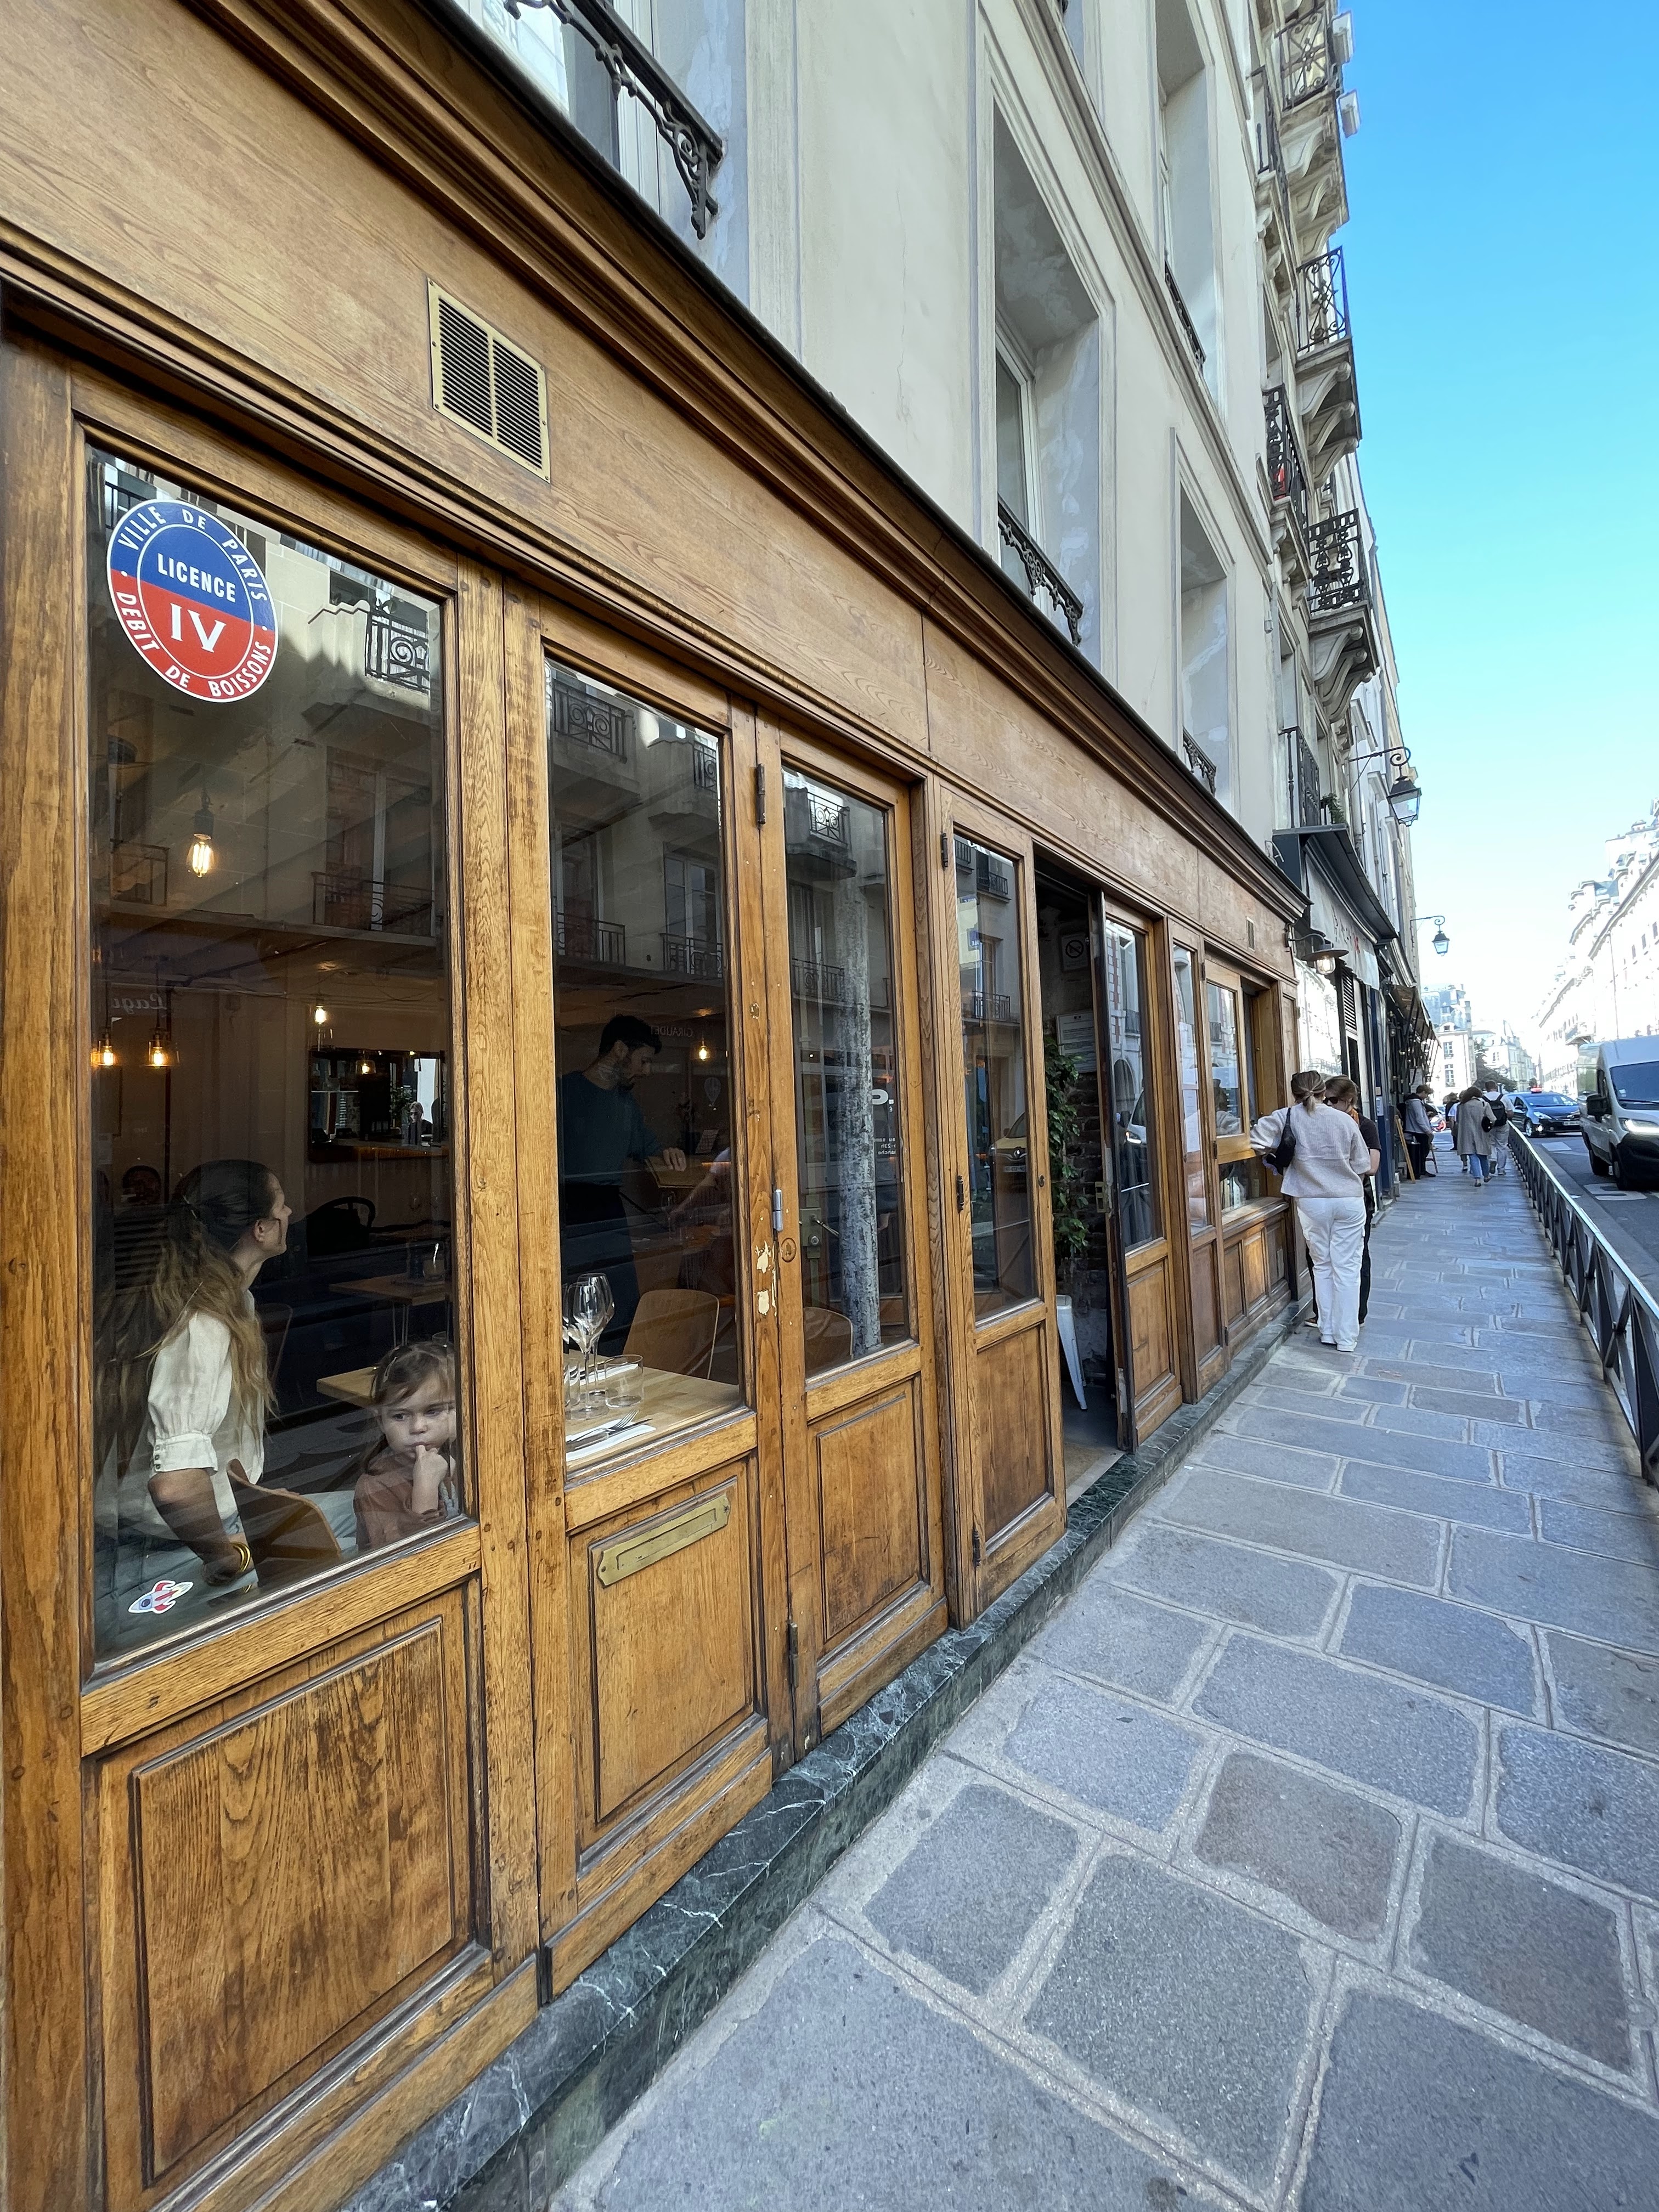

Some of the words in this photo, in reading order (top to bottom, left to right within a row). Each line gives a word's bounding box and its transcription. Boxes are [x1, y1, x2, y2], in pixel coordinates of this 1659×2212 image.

[117, 505, 166, 551] VILLE
[182, 508, 207, 531] DE
[222, 538, 268, 602] PARIS
[157, 553, 236, 603] LICENCE
[116, 591, 161, 651] DEBIT
[165, 665, 190, 688] DE
[207, 640, 272, 697] BOISSONS
[170, 602, 227, 653] IV
